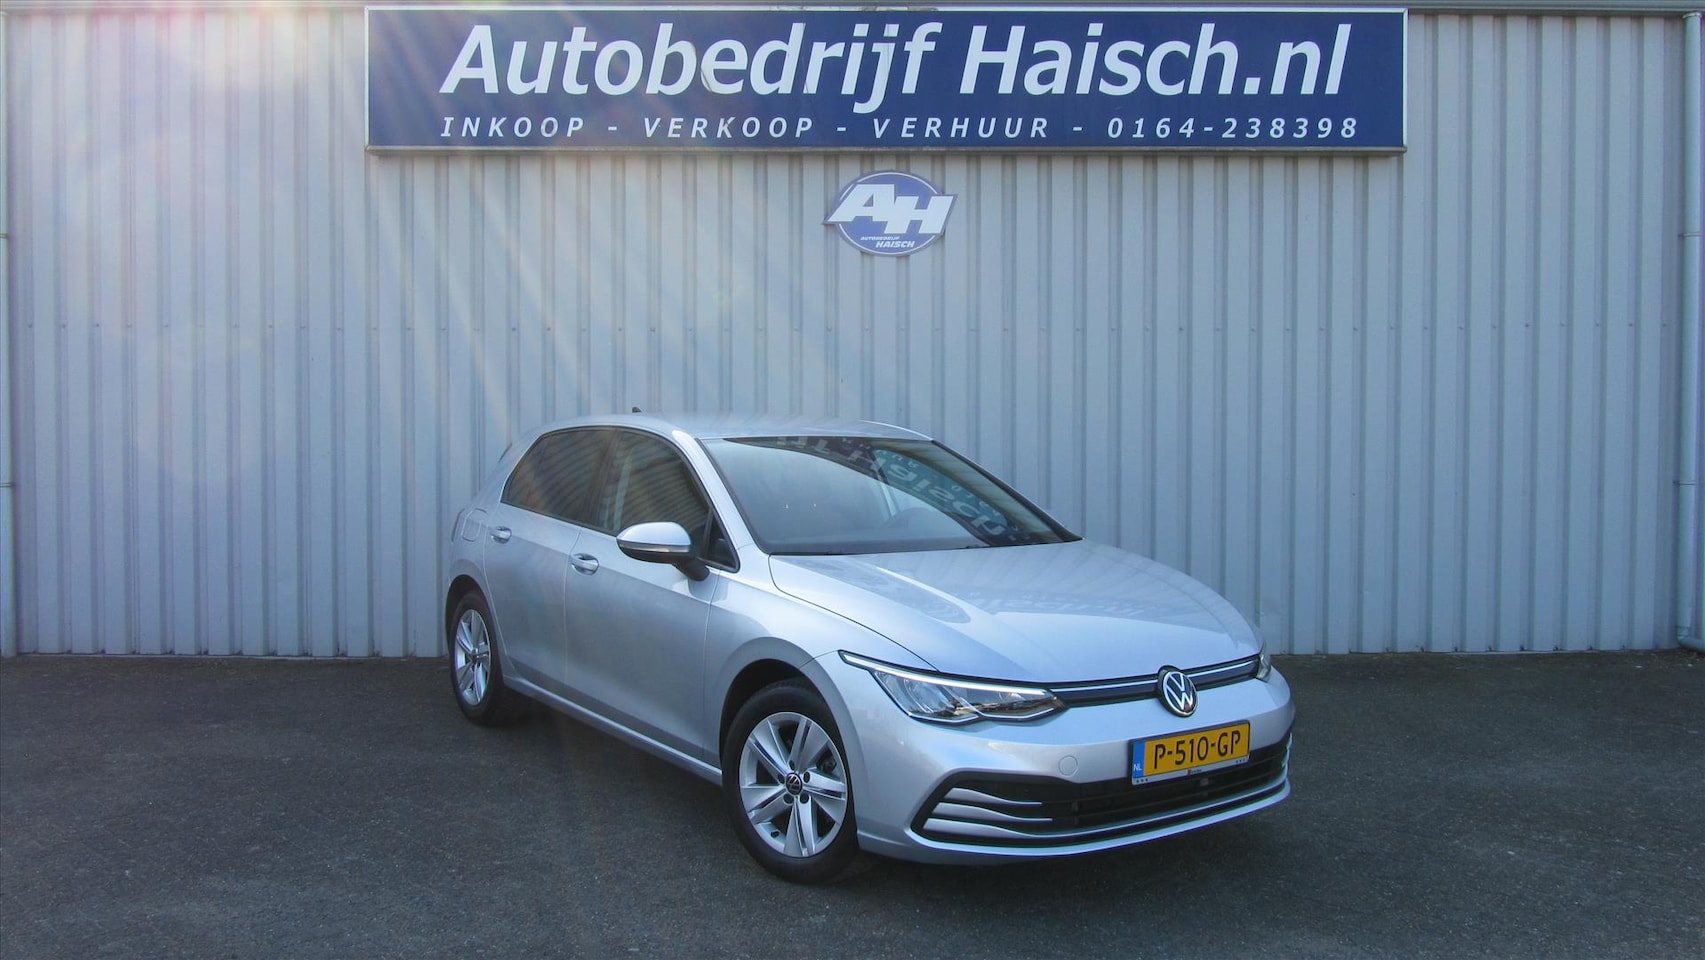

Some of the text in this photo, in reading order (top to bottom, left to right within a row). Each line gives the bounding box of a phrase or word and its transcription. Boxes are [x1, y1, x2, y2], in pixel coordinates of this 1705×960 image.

[438, 22, 1352, 114] Autobedrijf Haisch.nl
[440, 116, 584, 138] INKOOP
[643, 116, 813, 138] VERKOOP
[872, 117, 1048, 139] VERHUUR
[1107, 117, 1358, 139] 0164-238398
[827, 184, 954, 234] AH
[875, 240, 915, 248] HAISCH
[1153, 730, 1242, 770] P-510-GP
[1133, 763, 1143, 772] NL
